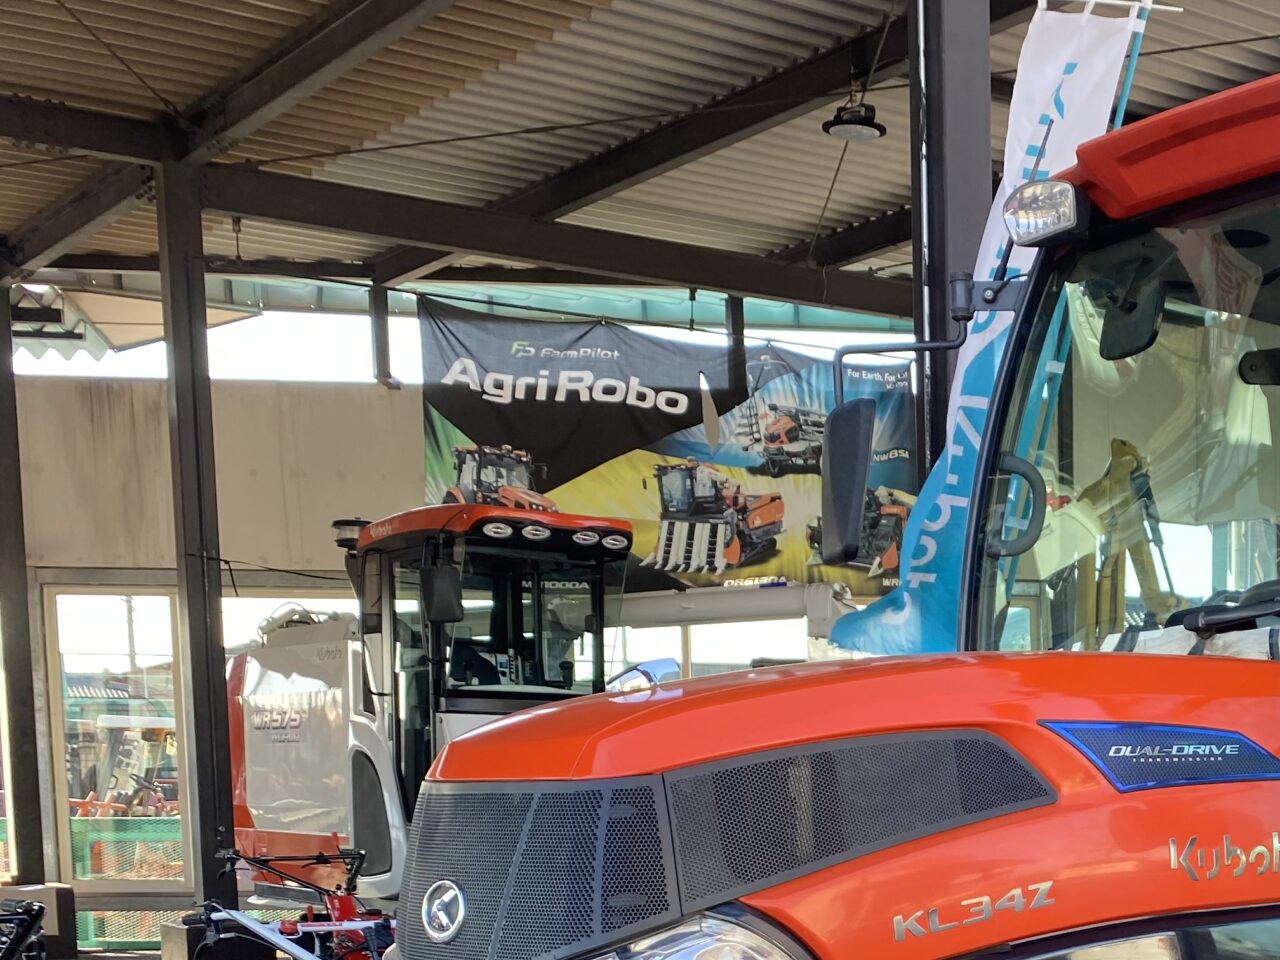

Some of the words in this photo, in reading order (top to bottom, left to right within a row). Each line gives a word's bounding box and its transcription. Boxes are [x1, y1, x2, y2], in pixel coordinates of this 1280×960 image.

[540, 347, 621, 360] FarmPilot
[848, 368, 860, 378] For
[885, 373, 896, 382] For
[440, 357, 689, 414] AgriRobo
[521, 580, 591, 590] M1000A
[1108, 744, 1240, 757] DUAL-DRIVE
[892, 880, 1056, 942] KL34Z
